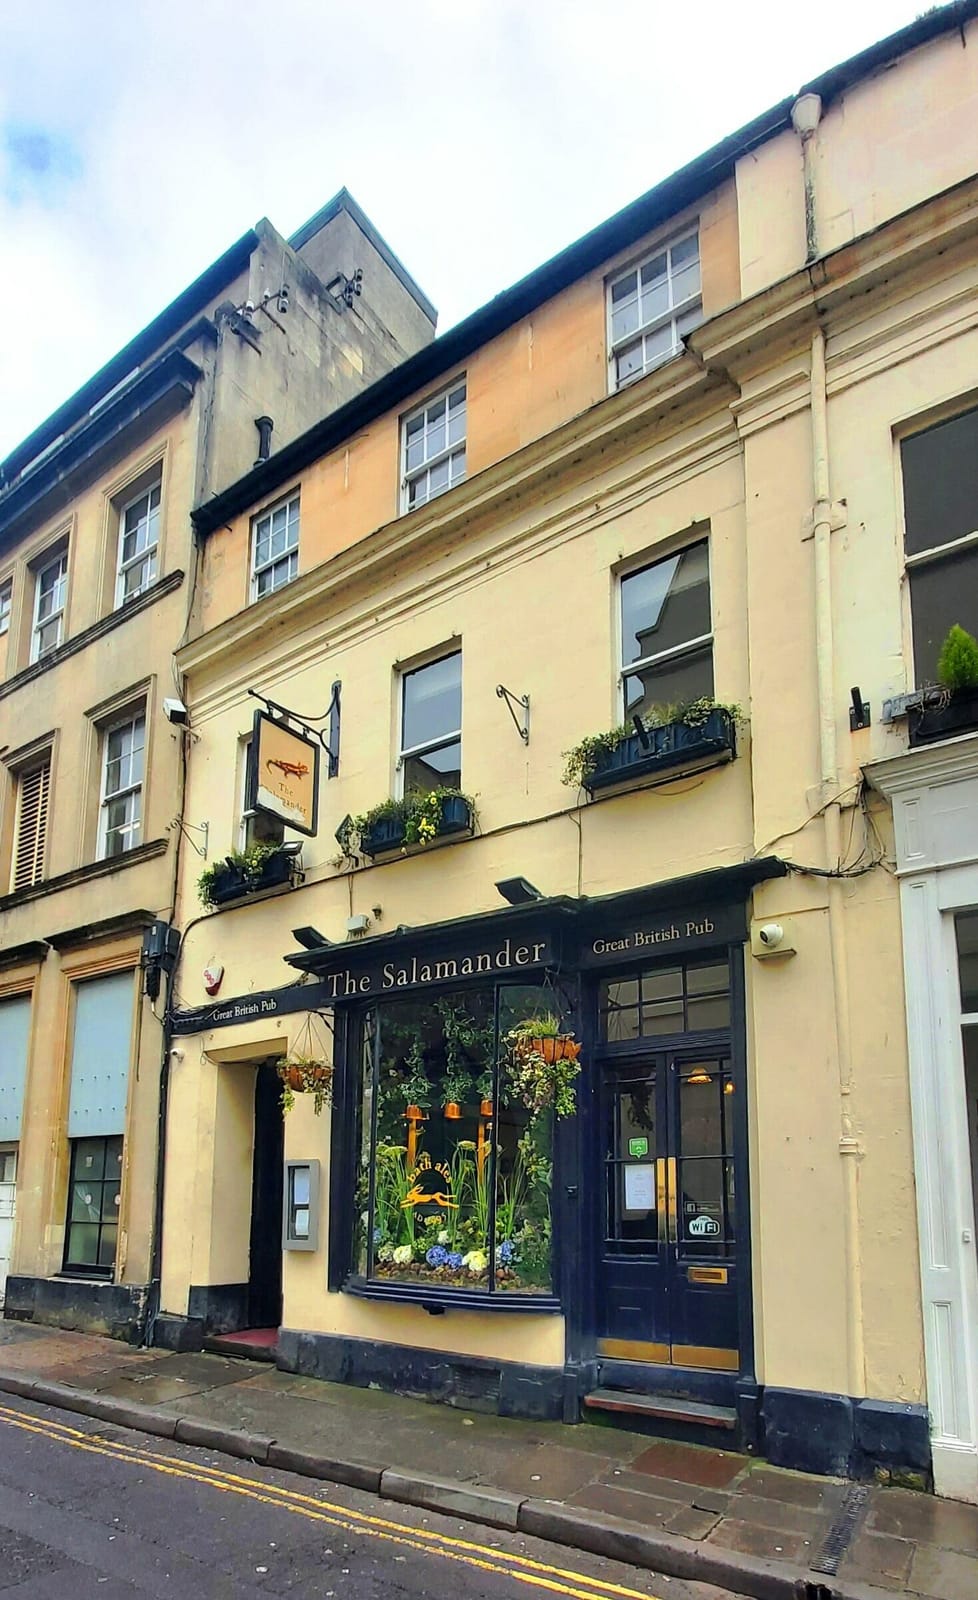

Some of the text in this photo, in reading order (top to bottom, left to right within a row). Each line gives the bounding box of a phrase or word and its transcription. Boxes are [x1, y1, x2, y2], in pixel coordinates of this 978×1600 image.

[278, 782, 293, 797] The
[592, 918, 714, 954] Great British Pub
[327, 939, 546, 998] The Salamander
[212, 998, 277, 1021] Great British Pub
[407, 1156, 453, 1184] bath ales
